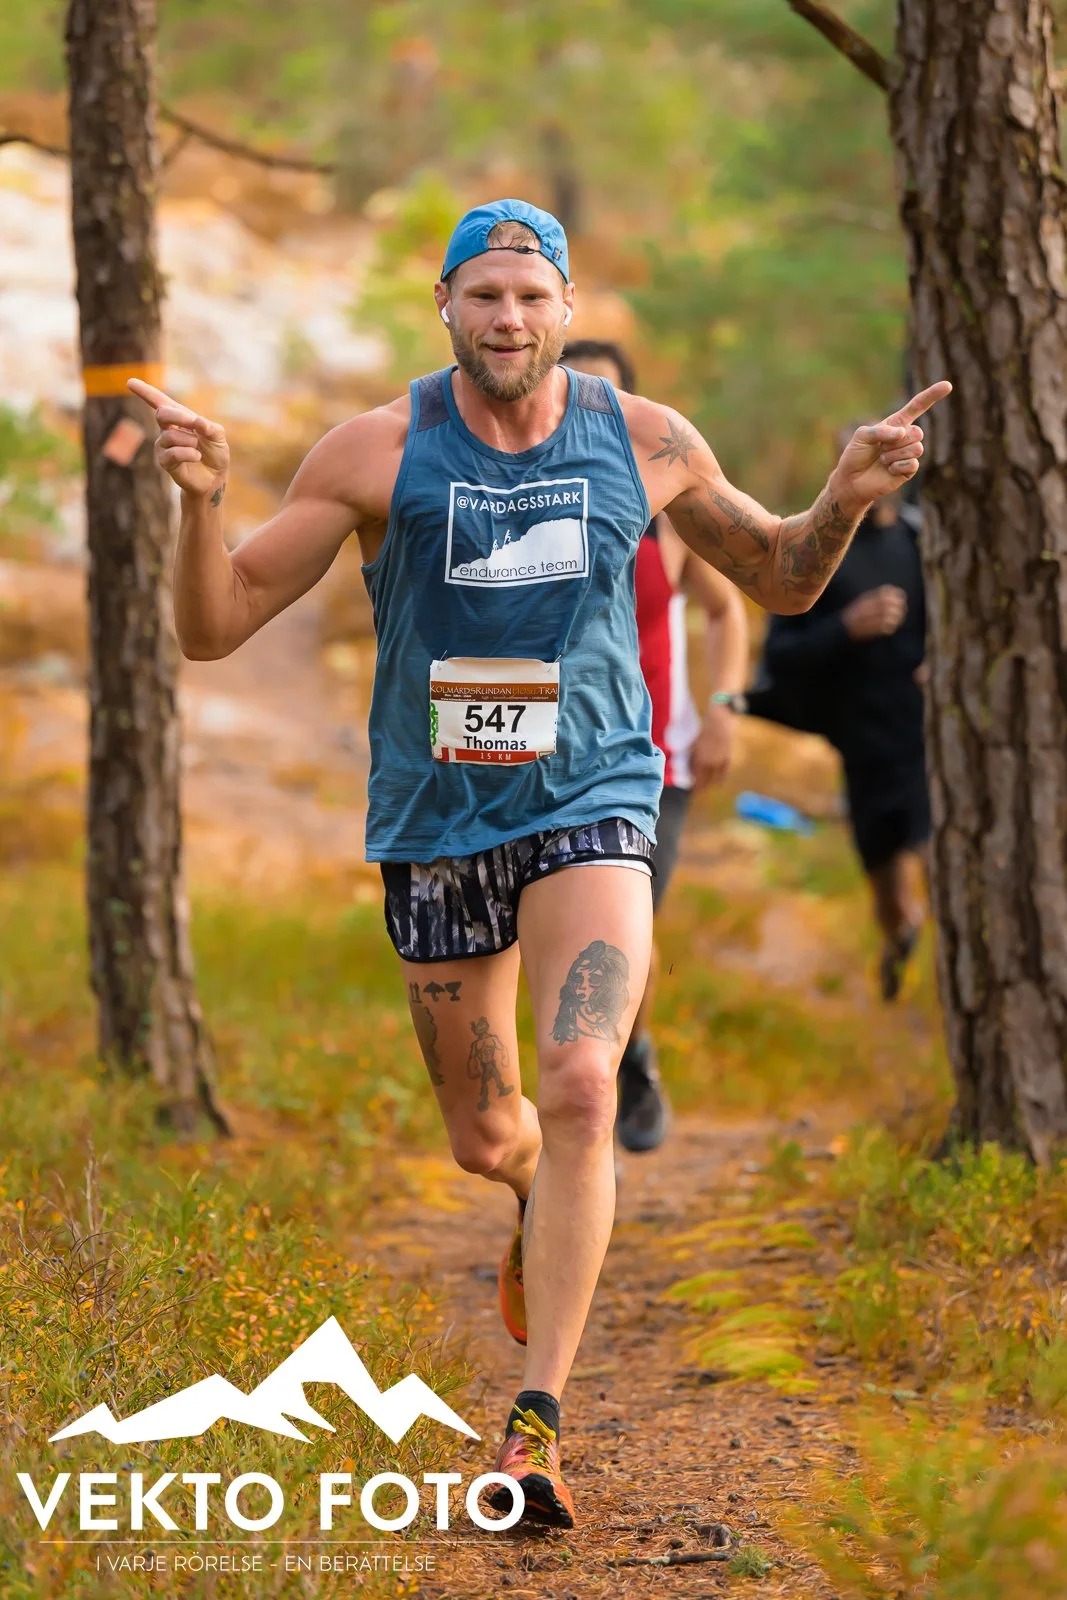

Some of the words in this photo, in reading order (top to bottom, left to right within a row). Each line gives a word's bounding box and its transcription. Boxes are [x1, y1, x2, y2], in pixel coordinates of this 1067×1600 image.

[457, 491, 581, 514] @VARDAGSSTARK
[460, 565, 536, 578] endurance
[541, 559, 578, 572] team
[464, 704, 527, 733] 547
[463, 736, 527, 751] Thomas
[480, 752, 492, 760] 15
[498, 753, 512, 761] KM
